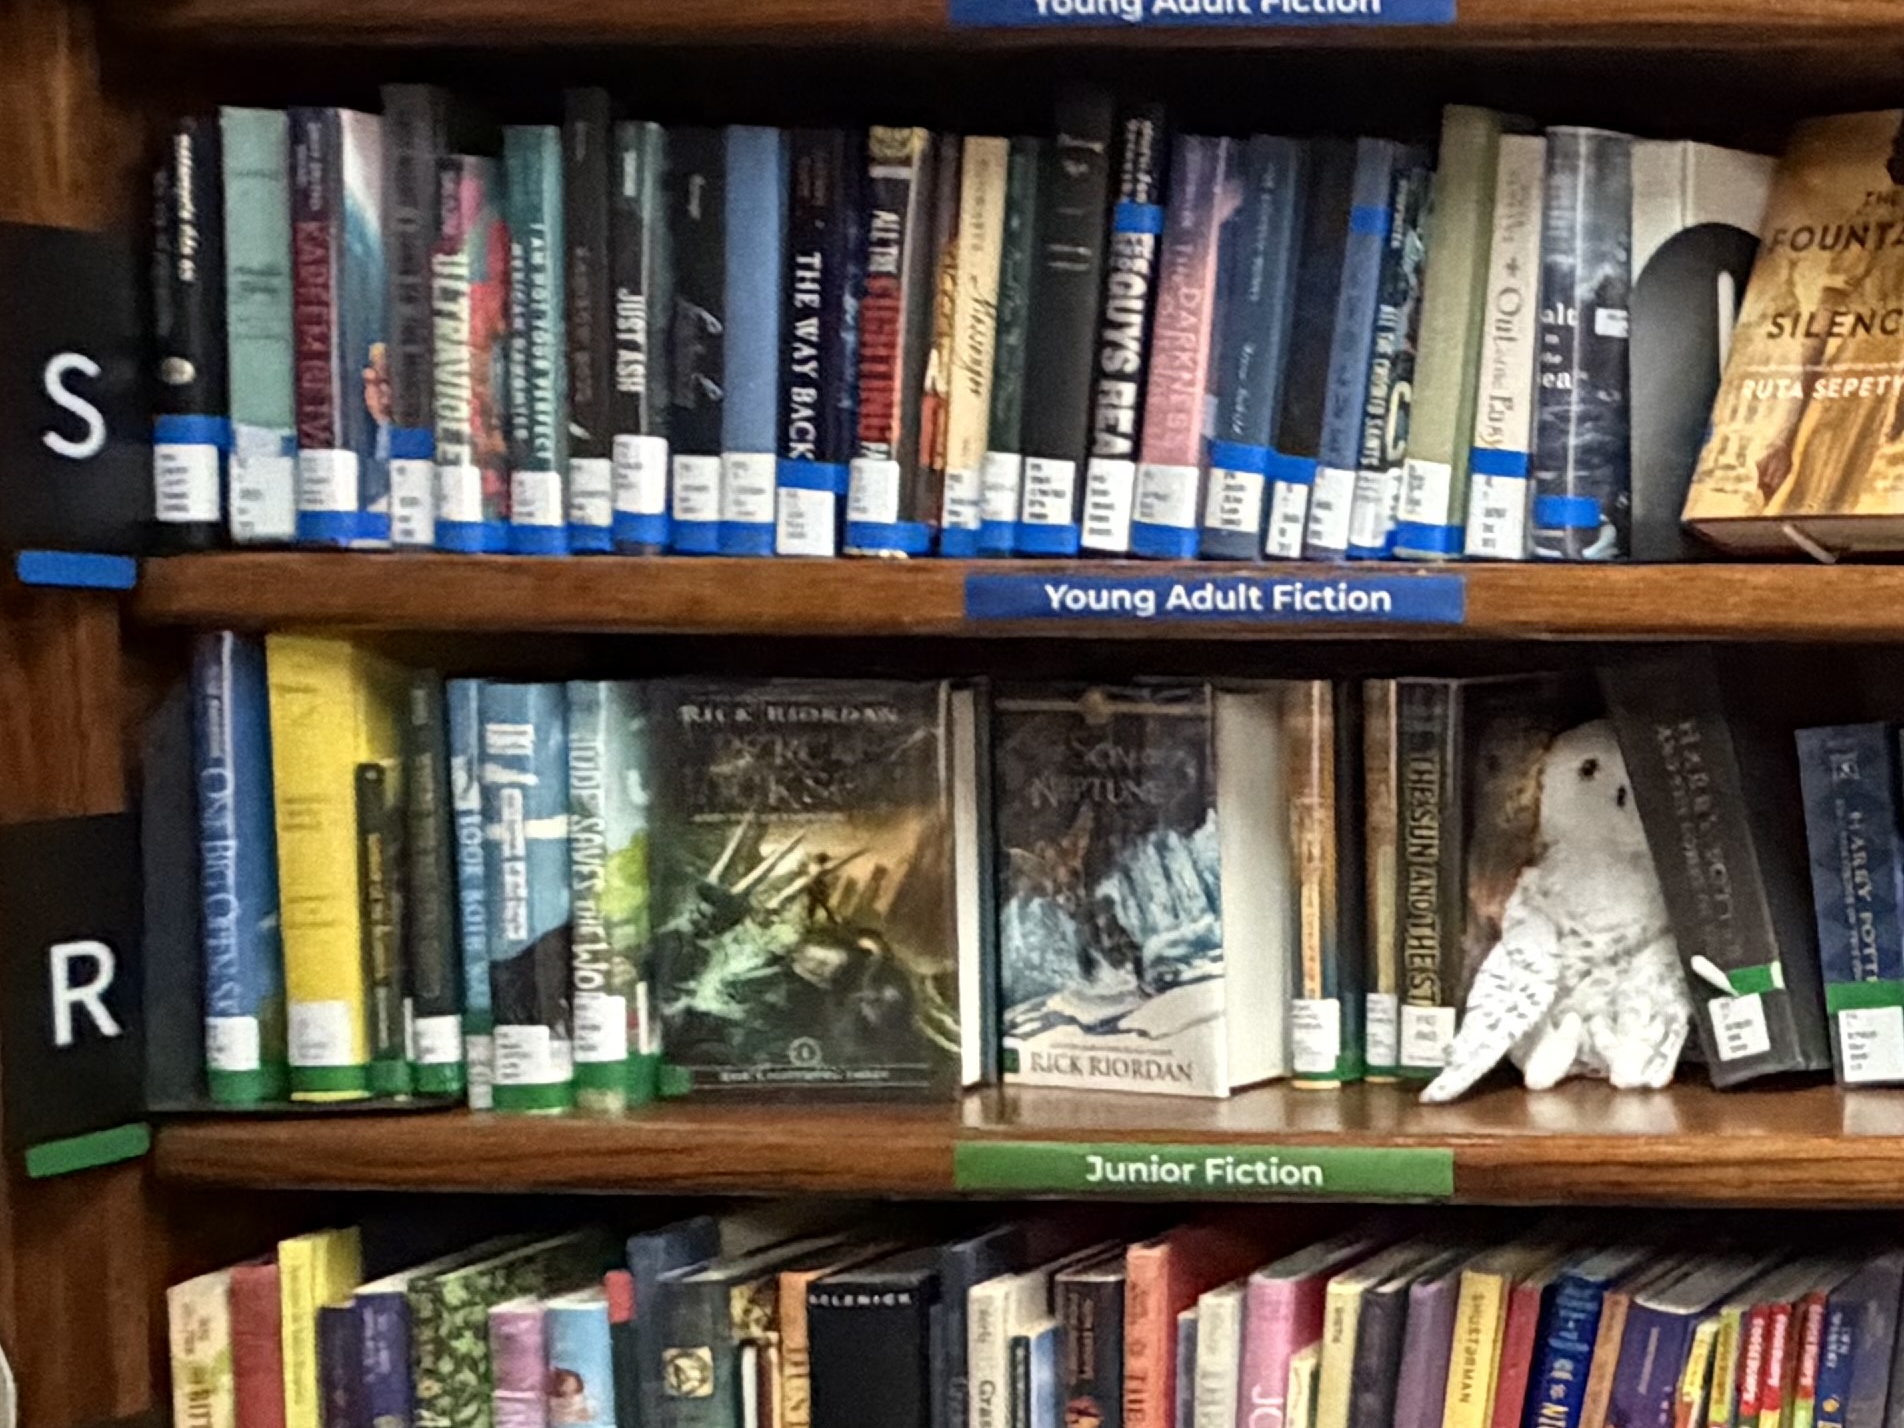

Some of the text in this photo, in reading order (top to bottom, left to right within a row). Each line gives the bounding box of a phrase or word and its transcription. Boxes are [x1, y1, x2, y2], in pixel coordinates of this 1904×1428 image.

[789, 251, 822, 460] THE WAY BACK
[1742, 373, 1805, 401] RUTA
[41, 351, 106, 460] S
[1046, 585, 1391, 616] Young Adult Fiction
[48, 939, 124, 1048] R
[1029, 1050, 1193, 1084] RICK RIORDAN
[1086, 1155, 1323, 1188] Junior Fiction
